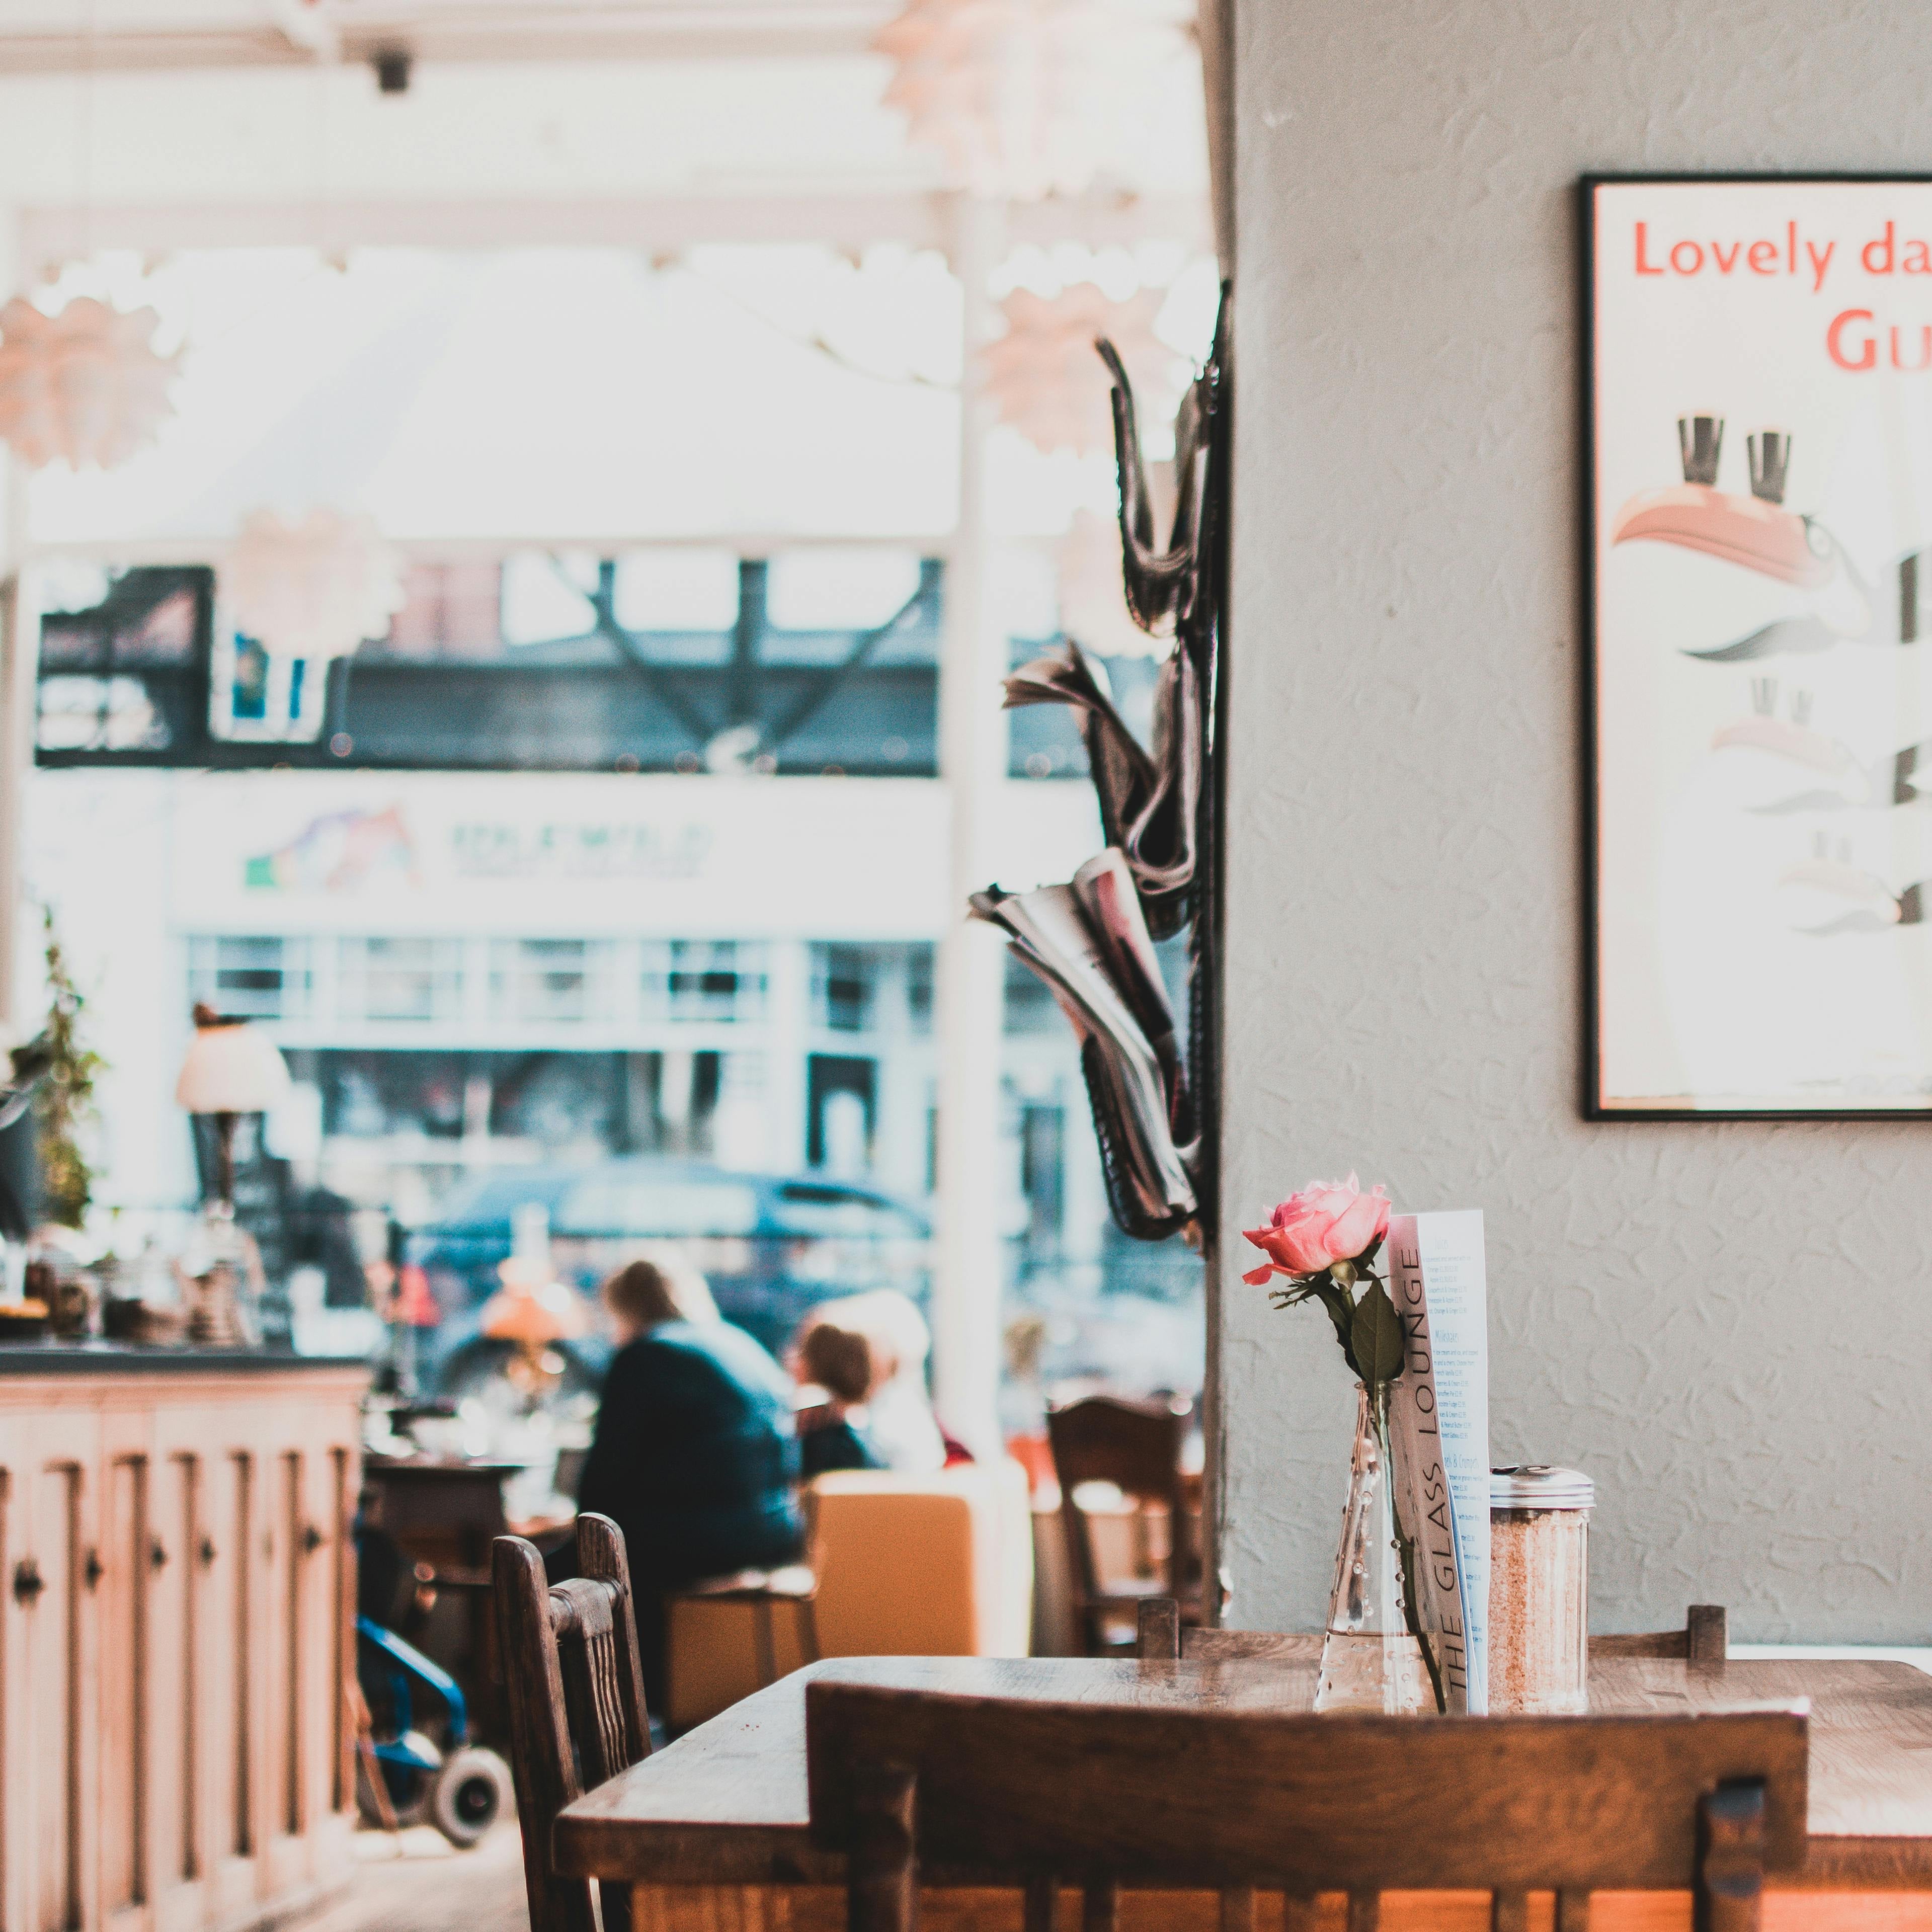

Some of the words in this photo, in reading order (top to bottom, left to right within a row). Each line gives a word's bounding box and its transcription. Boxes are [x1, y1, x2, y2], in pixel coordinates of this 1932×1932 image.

[1634, 219, 1836, 293] Lovely
[1400, 1248, 1437, 1435] LOUNGE
[1422, 1462, 1455, 1592] GLASS
[1440, 1613, 1468, 1694] THE
